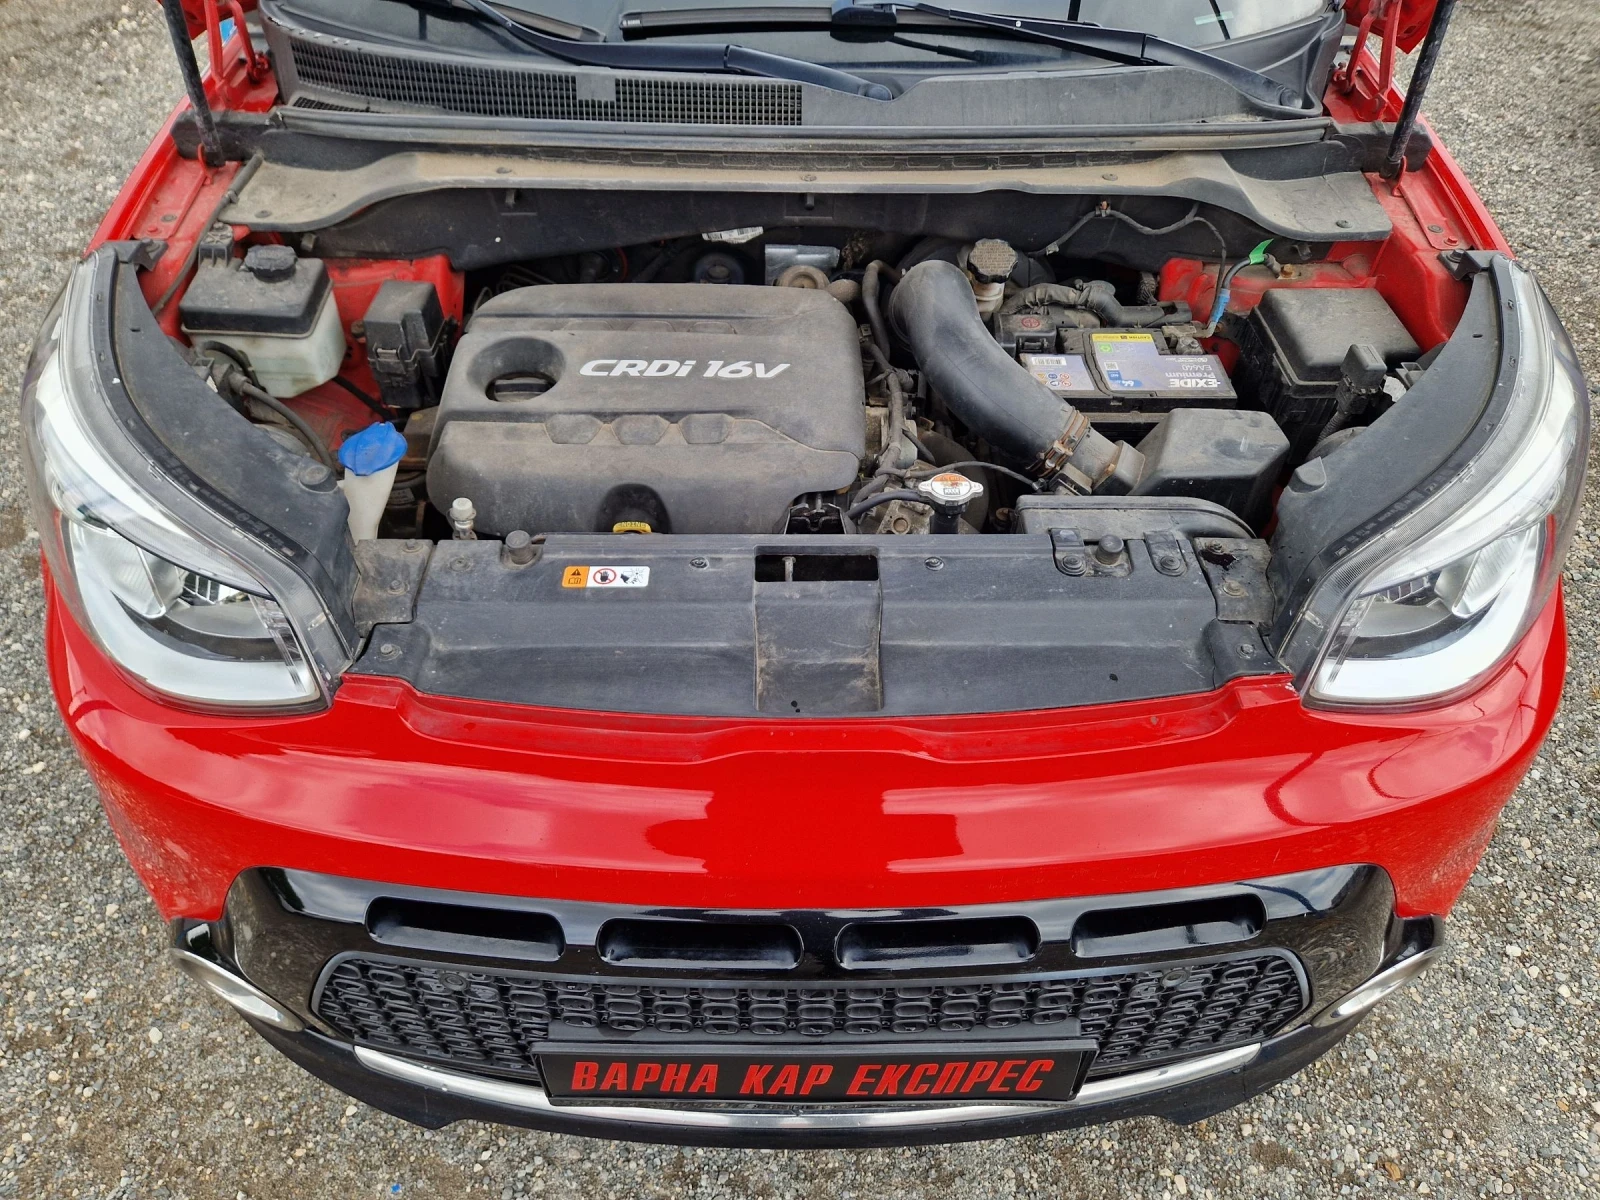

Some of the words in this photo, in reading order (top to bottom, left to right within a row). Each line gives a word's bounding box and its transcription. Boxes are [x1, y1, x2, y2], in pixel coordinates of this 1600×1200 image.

[580, 360, 696, 377] CRDi
[703, 361, 790, 378] 16V
[1169, 379, 1220, 388] EXIDE
[572, 1061, 718, 1093] ВАРНА
[740, 1064, 833, 1095] КАР
[847, 1060, 1054, 1095] ЕКСПРЕС
